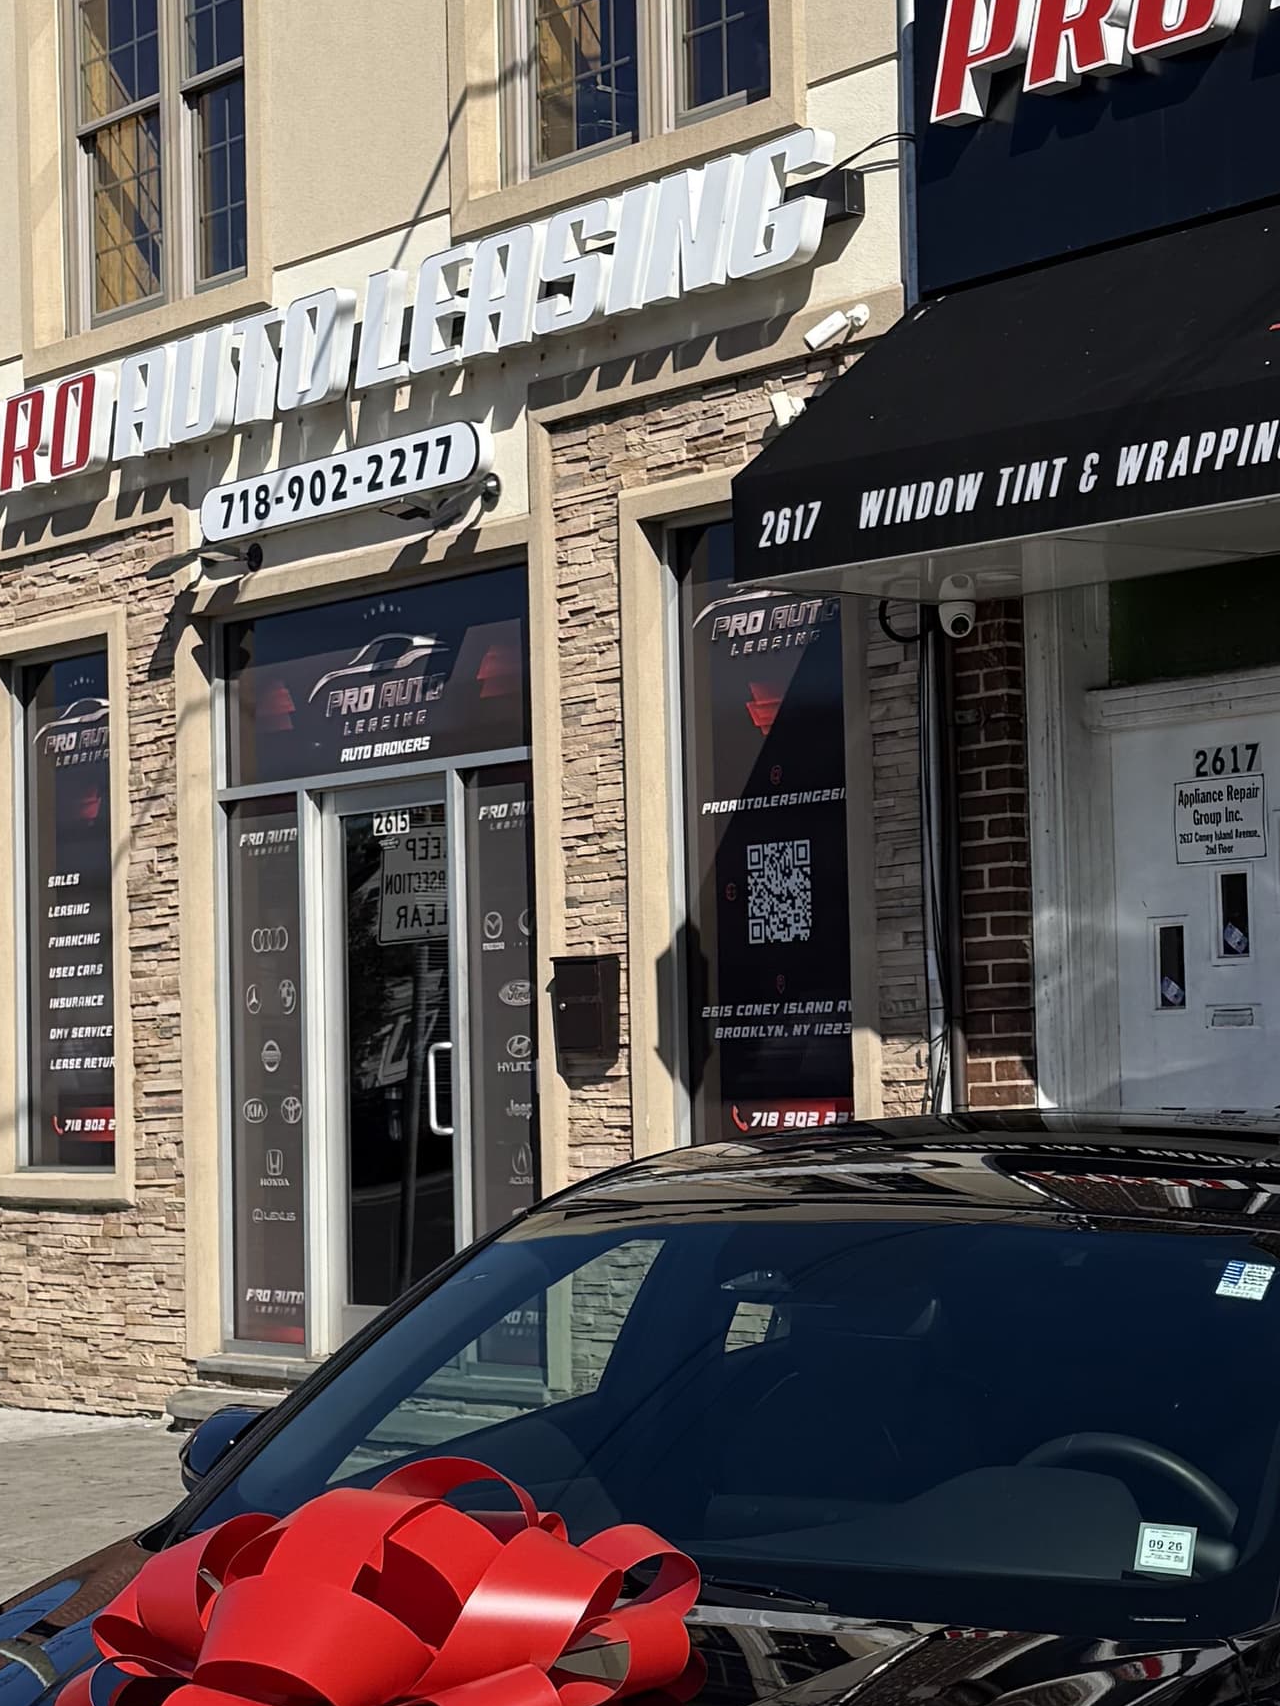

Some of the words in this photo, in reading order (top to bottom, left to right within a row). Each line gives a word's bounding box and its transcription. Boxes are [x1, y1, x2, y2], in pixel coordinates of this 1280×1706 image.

[113, 288, 356, 462] AUTO
[355, 126, 835, 389] LEASING
[220, 436, 452, 526] 718-902-2277
[759, 500, 821, 548] 2617
[859, 470, 984, 531] WINDOW
[997, 457, 1069, 507] TINT
[1078, 453, 1100, 493] &
[712, 610, 765, 641] PRO
[769, 597, 841, 631] AUTO
[730, 630, 821, 657] LEASING
[325, 685, 375, 717] PRO
[379, 673, 445, 709] AUTO
[344, 709, 427, 736] LEASING
[44, 731, 76, 755] PRO
[79, 728, 110, 749] AUT
[340, 745, 372, 762] AUTO
[374, 736, 431, 757] BROKERS
[1195, 743, 1259, 777] 2617
[702, 788, 847, 815] PROAUTOLEASING261
[1178, 790, 1223, 809] Appliance
[1227, 783, 1260, 802] Repair
[478, 804, 509, 820] PRO
[510, 802, 530, 816] AU
[1193, 809, 1221, 827] Group
[1225, 807, 1243, 822] Inc.
[375, 814, 408, 835] 2615
[240, 831, 264, 847] PRO
[265, 828, 297, 844] AUTO
[48, 873, 80, 887] SALES
[48, 903, 90, 917] LEASING
[48, 933, 100, 948] FINANCING
[49, 967, 75, 978] USED
[77, 963, 103, 976] CARS
[49, 995, 104, 1009] INSURANCE
[702, 1006, 733, 1018] 2615
[736, 1003, 779, 1016] CONEY
[784, 1001, 833, 1014] ISLAND
[837, 1000, 852, 1011] AV
[50, 1028, 69, 1040] DMV
[71, 1025, 113, 1038] SERVICE
[714, 1025, 788, 1038] BROOKLYN,
[793, 1024, 813, 1036] NY
[815, 1023, 852, 1035] 11223
[50, 1057, 82, 1070] LEASE
[84, 1057, 115, 1068] RETUR
[497, 1062, 535, 1072] HYUND
[246, 1104, 264, 1118] KIA
[751, 1112, 779, 1127] 718
[784, 1112, 820, 1127] 902
[65, 1119, 82, 1132] 718
[84, 1118, 107, 1131] 902
[264, 1212, 296, 1221] LEXUS
[246, 1289, 270, 1302] PRO
[272, 1290, 304, 1303] AUTO
[1149, 1539, 1164, 1550] 09
[1168, 1541, 1183, 1551] 26
